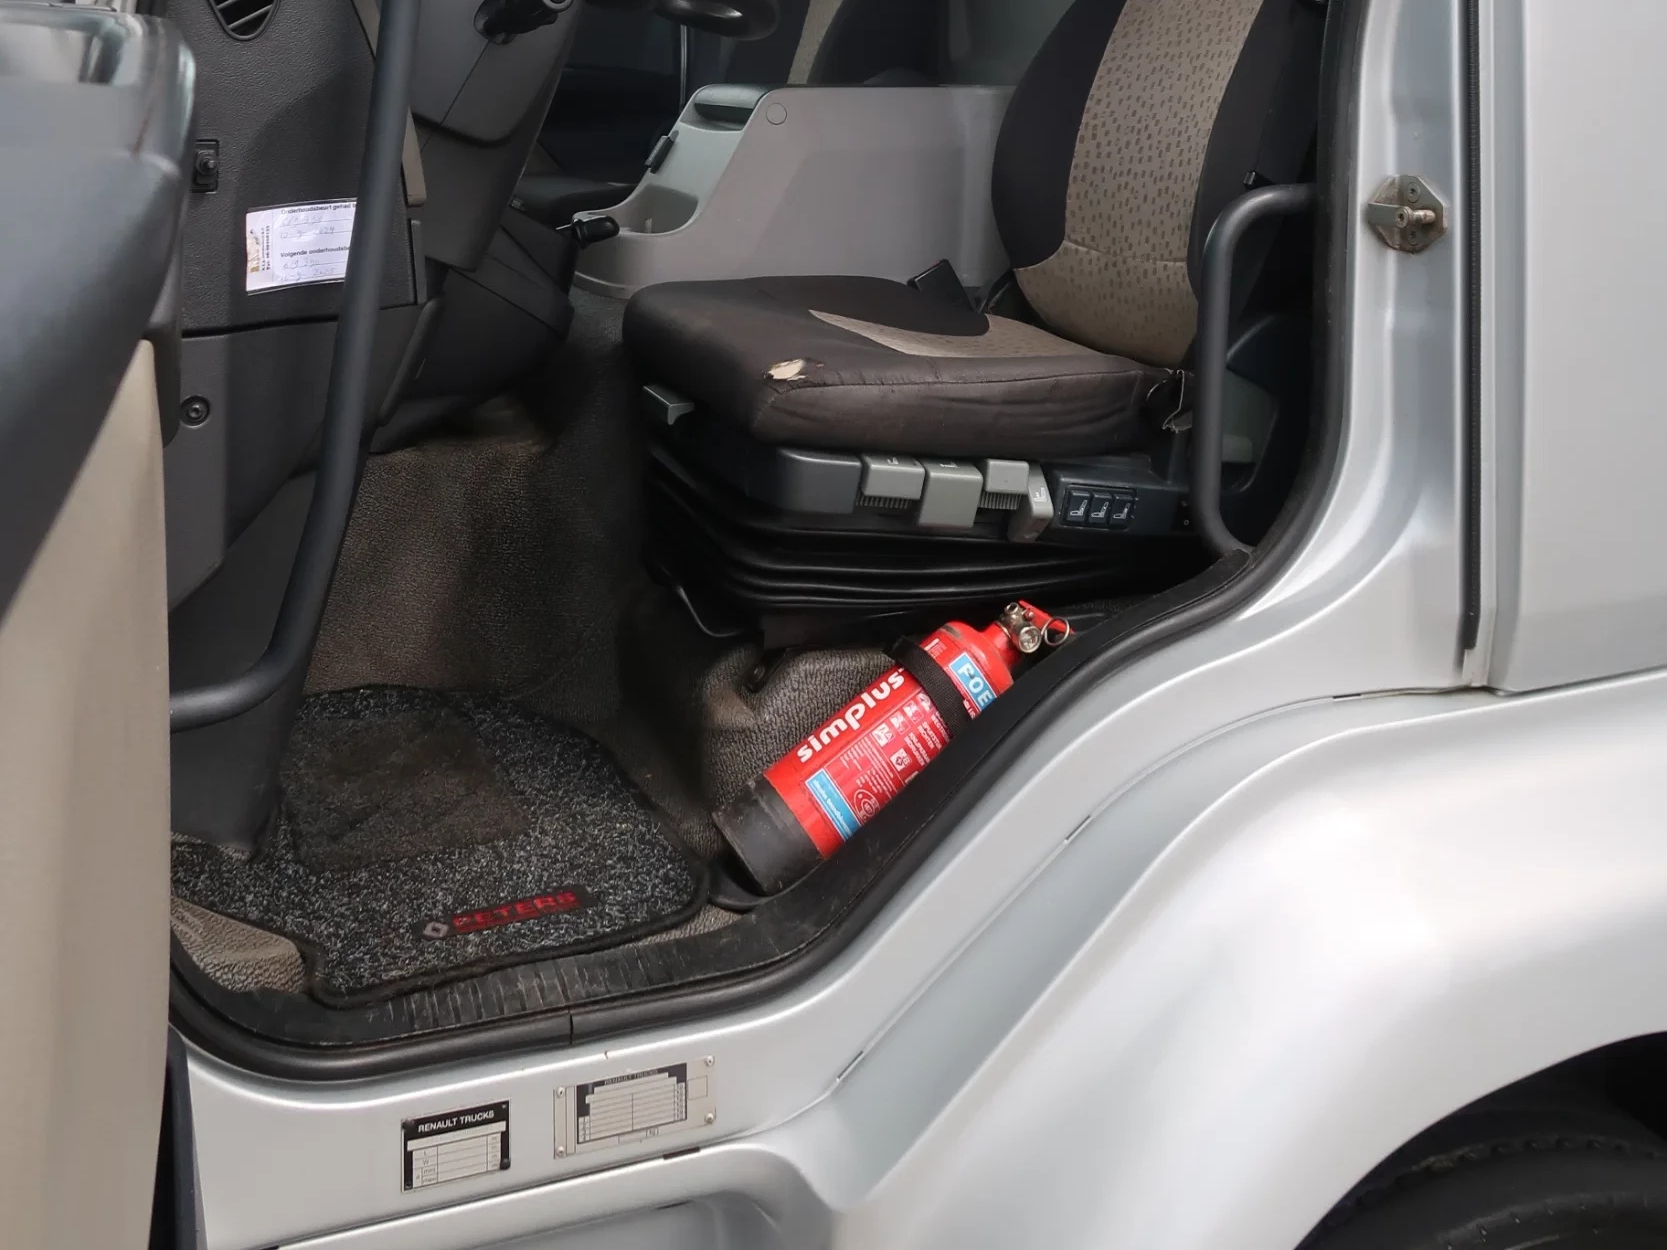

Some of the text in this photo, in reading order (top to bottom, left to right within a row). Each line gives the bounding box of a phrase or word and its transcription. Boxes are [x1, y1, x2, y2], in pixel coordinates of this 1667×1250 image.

[281, 205, 332, 214] Onderhoudsbeurt
[280, 250, 308, 259] Volgende
[796, 672, 905, 763] simplus
[418, 1110, 495, 1133] RENAULT TRUCKS
